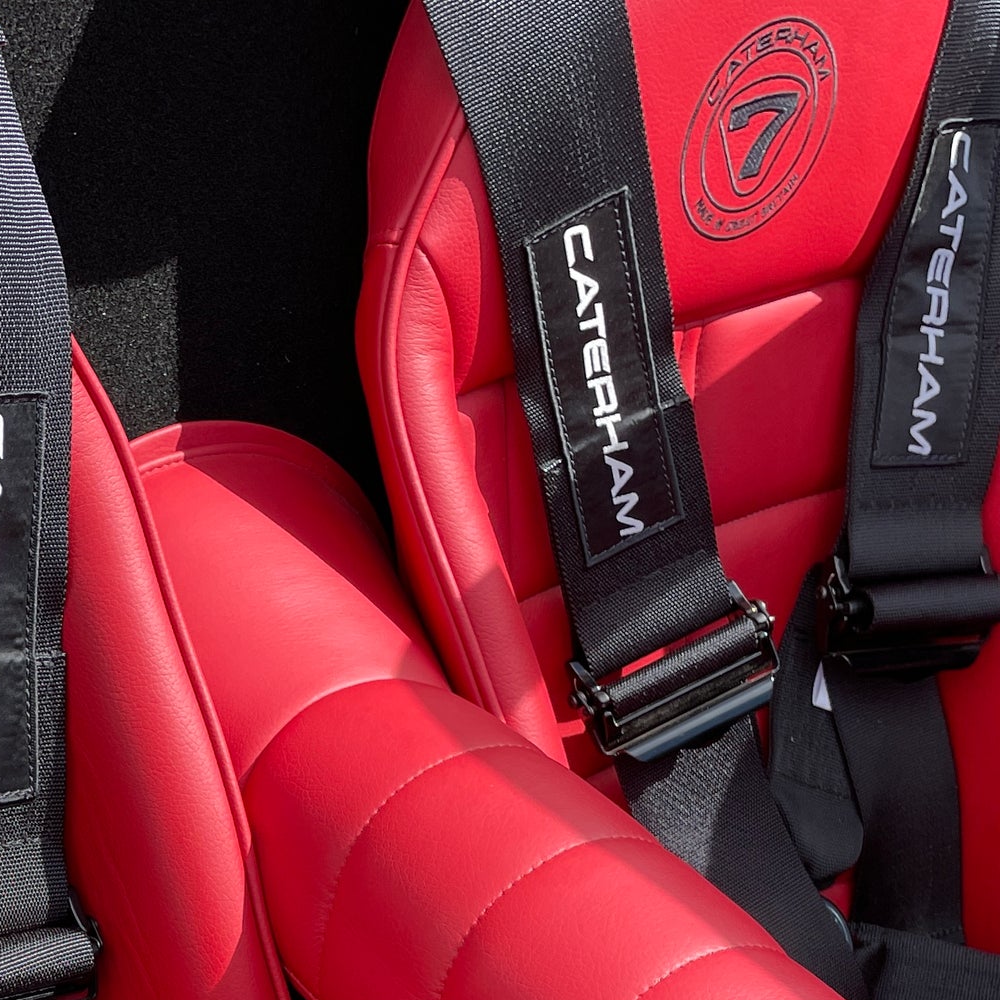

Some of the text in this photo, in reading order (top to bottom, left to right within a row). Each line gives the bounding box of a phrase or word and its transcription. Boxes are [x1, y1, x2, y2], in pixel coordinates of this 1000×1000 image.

[708, 27, 832, 107] CATERHAM
[728, 92, 800, 181] 7
[563, 224, 643, 536] CATERHAM
[907, 131, 971, 455] CATERHAM
